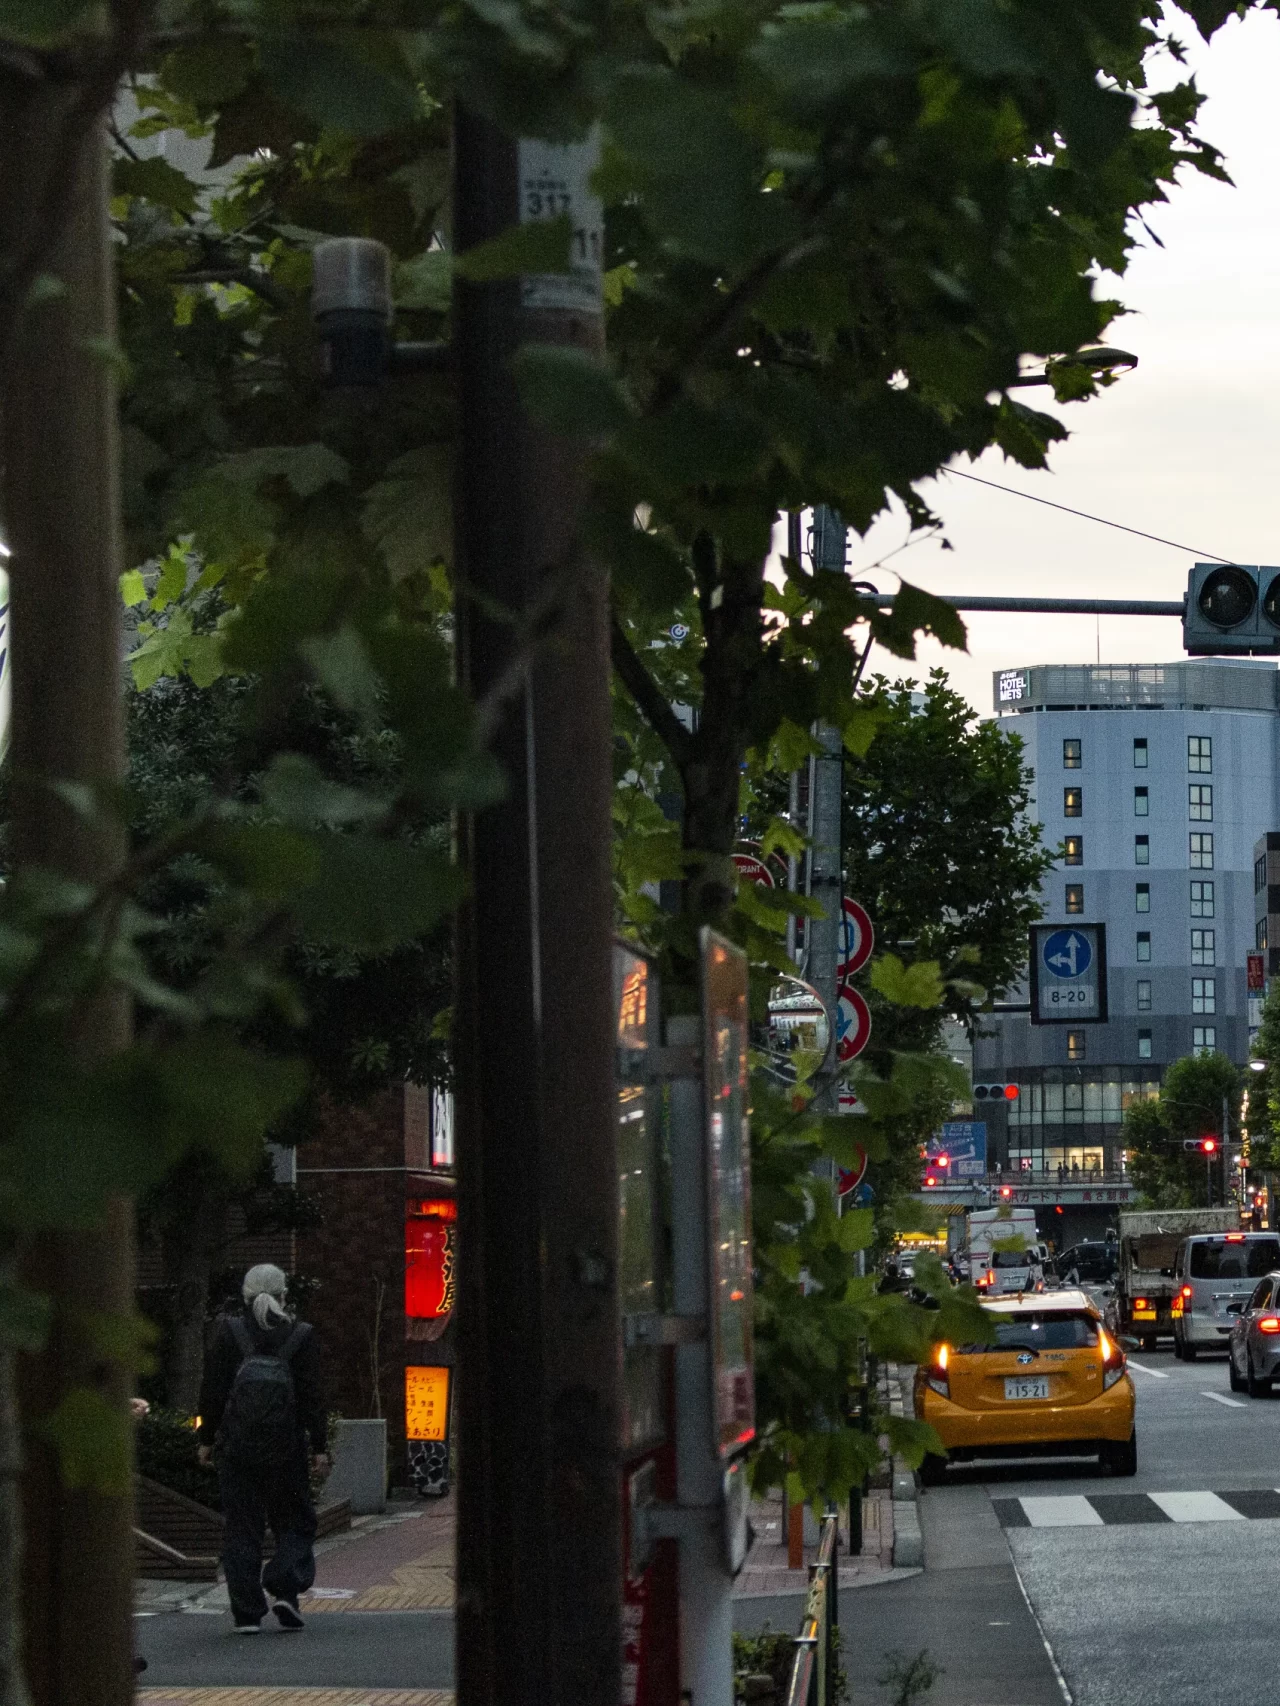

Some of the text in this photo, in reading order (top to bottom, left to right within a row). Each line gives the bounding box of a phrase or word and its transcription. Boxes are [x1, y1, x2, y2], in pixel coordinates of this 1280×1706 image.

[1000, 677, 1027, 691] HOTEL
[1000, 689, 1022, 701] METS
[1050, 989, 1086, 1004] 8-20
